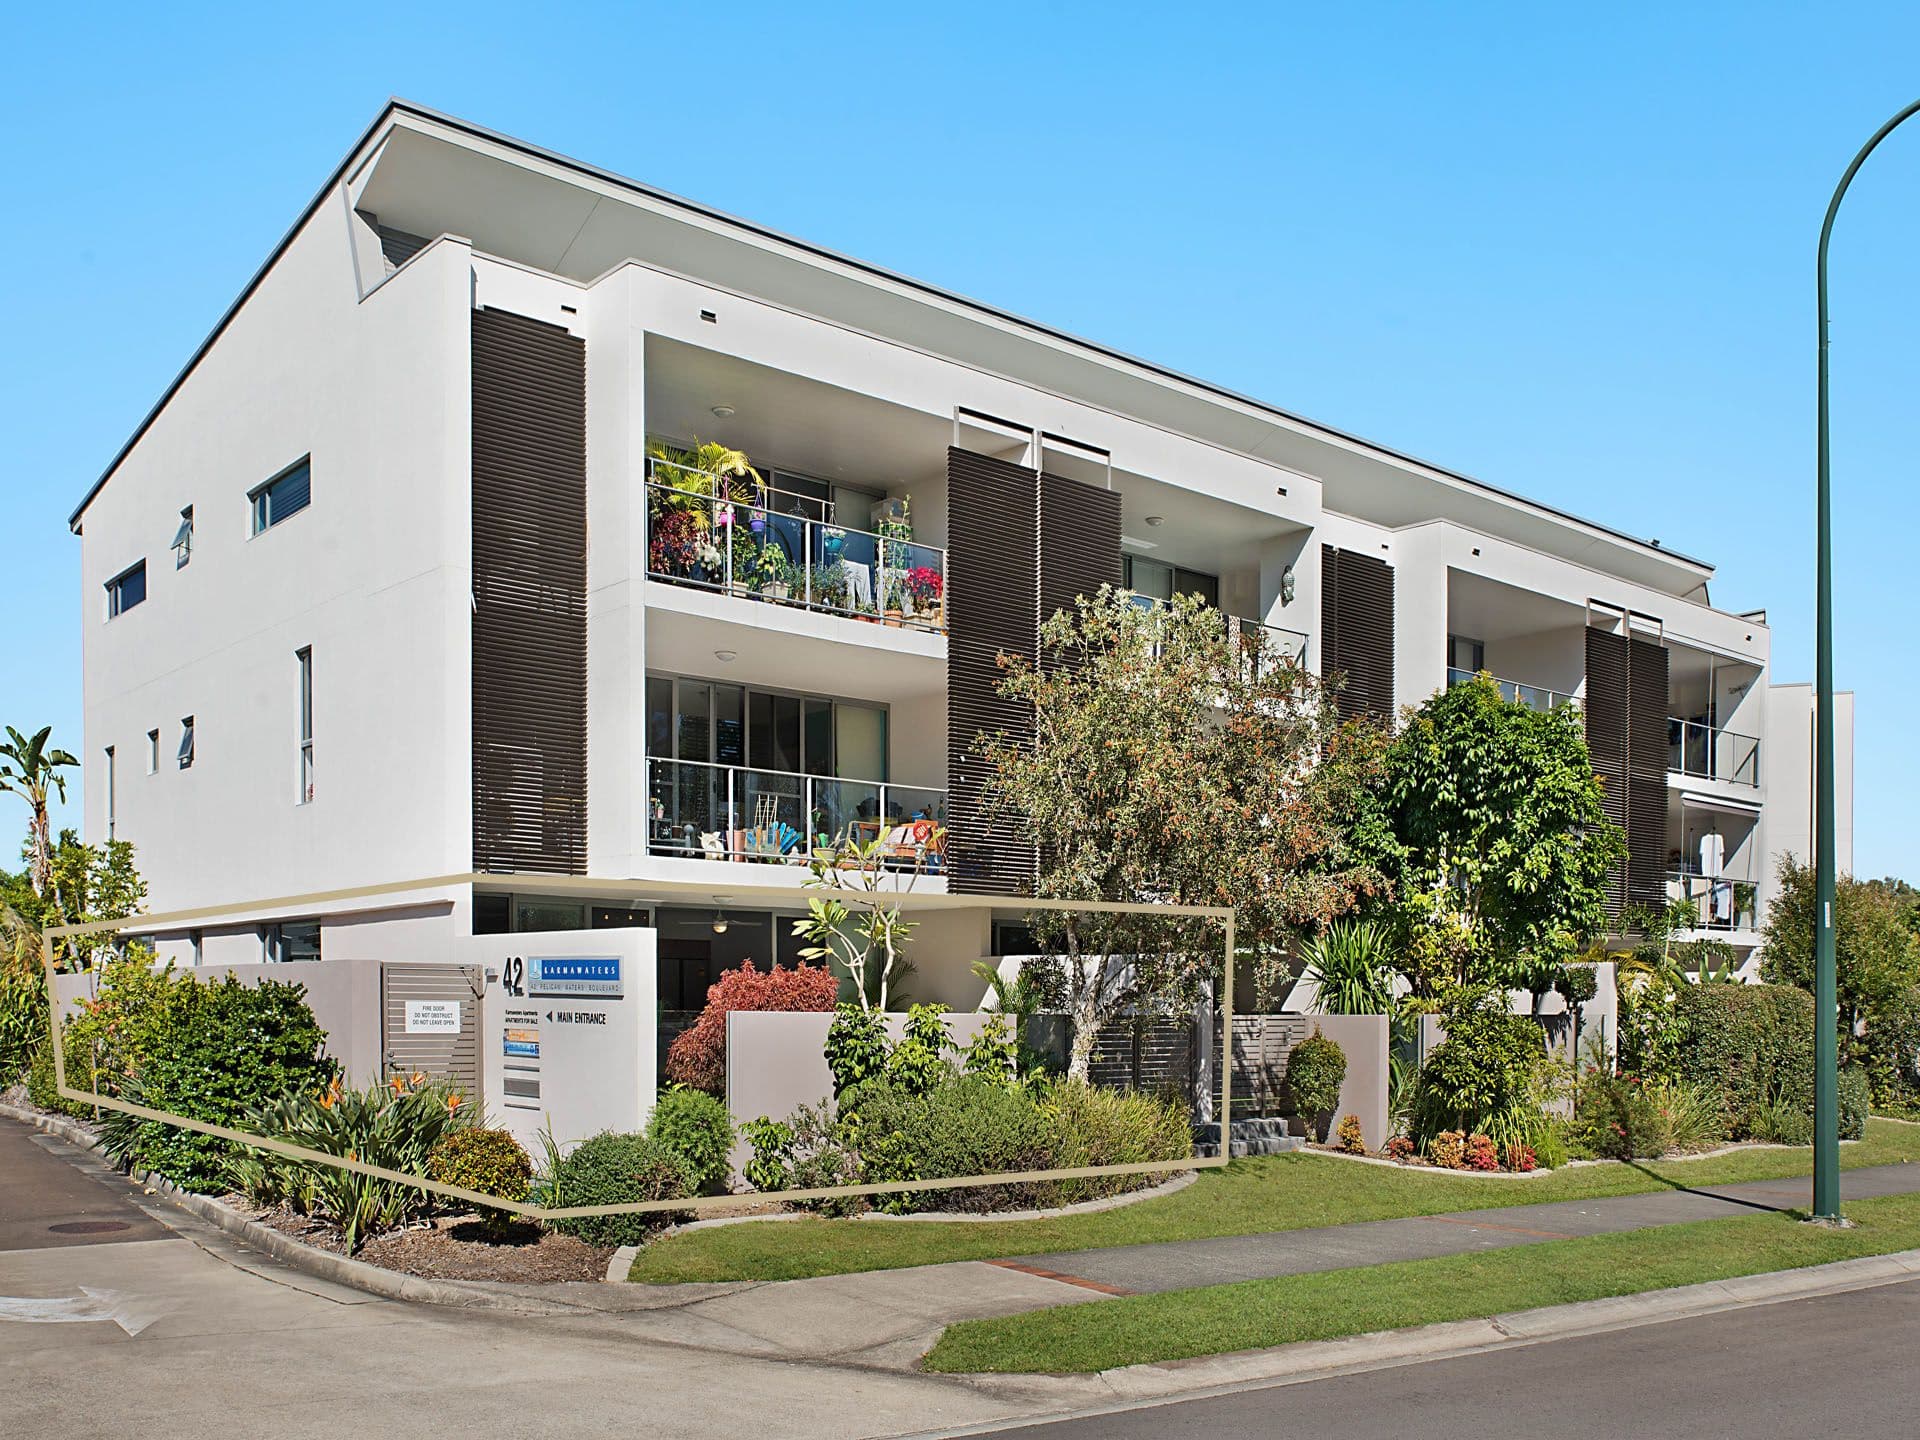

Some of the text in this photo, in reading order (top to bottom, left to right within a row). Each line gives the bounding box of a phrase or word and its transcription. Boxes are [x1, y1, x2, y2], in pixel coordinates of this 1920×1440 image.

[503, 957, 524, 997] 42
[540, 983, 561, 991] PELICAN
[588, 984, 619, 992] BOULEVARD
[557, 1011, 606, 1025] MAIN ENTRANCE
